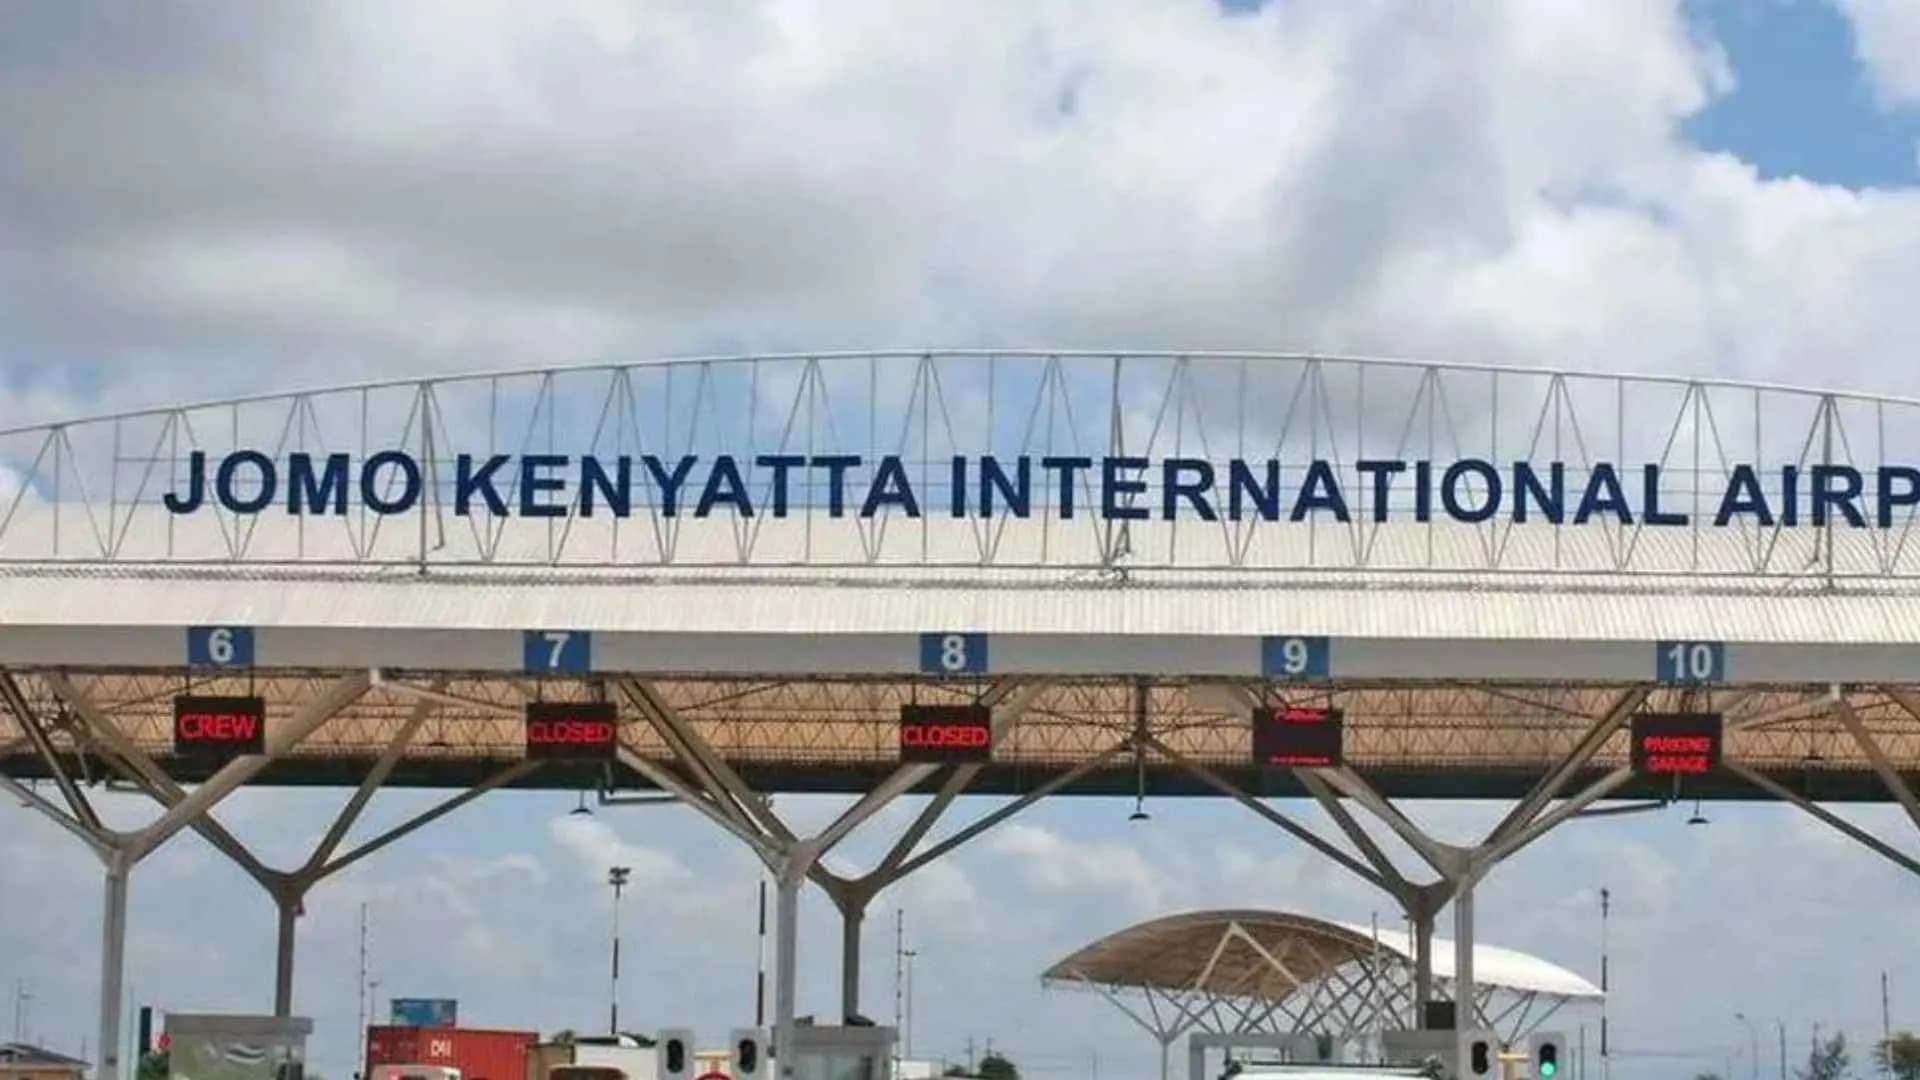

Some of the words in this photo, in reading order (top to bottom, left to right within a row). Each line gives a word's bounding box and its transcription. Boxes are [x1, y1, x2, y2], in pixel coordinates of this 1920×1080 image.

[163, 450, 422, 515] JOMO
[454, 453, 920, 518] KENYATTA
[951, 456, 1689, 525] INTERNATIONAL
[1714, 464, 1920, 529] AIRP
[208, 628, 233, 665] 6
[544, 632, 570, 668] 7
[941, 634, 966, 671] 8
[1283, 638, 1308, 673] 9
[1668, 643, 1713, 679] 10
[179, 713, 258, 740] CREW
[529, 721, 614, 742] CLOSED
[903, 724, 988, 746] CLOSED
[1643, 736, 1711, 752] PARKING
[1647, 755, 1709, 773] GARAGE
